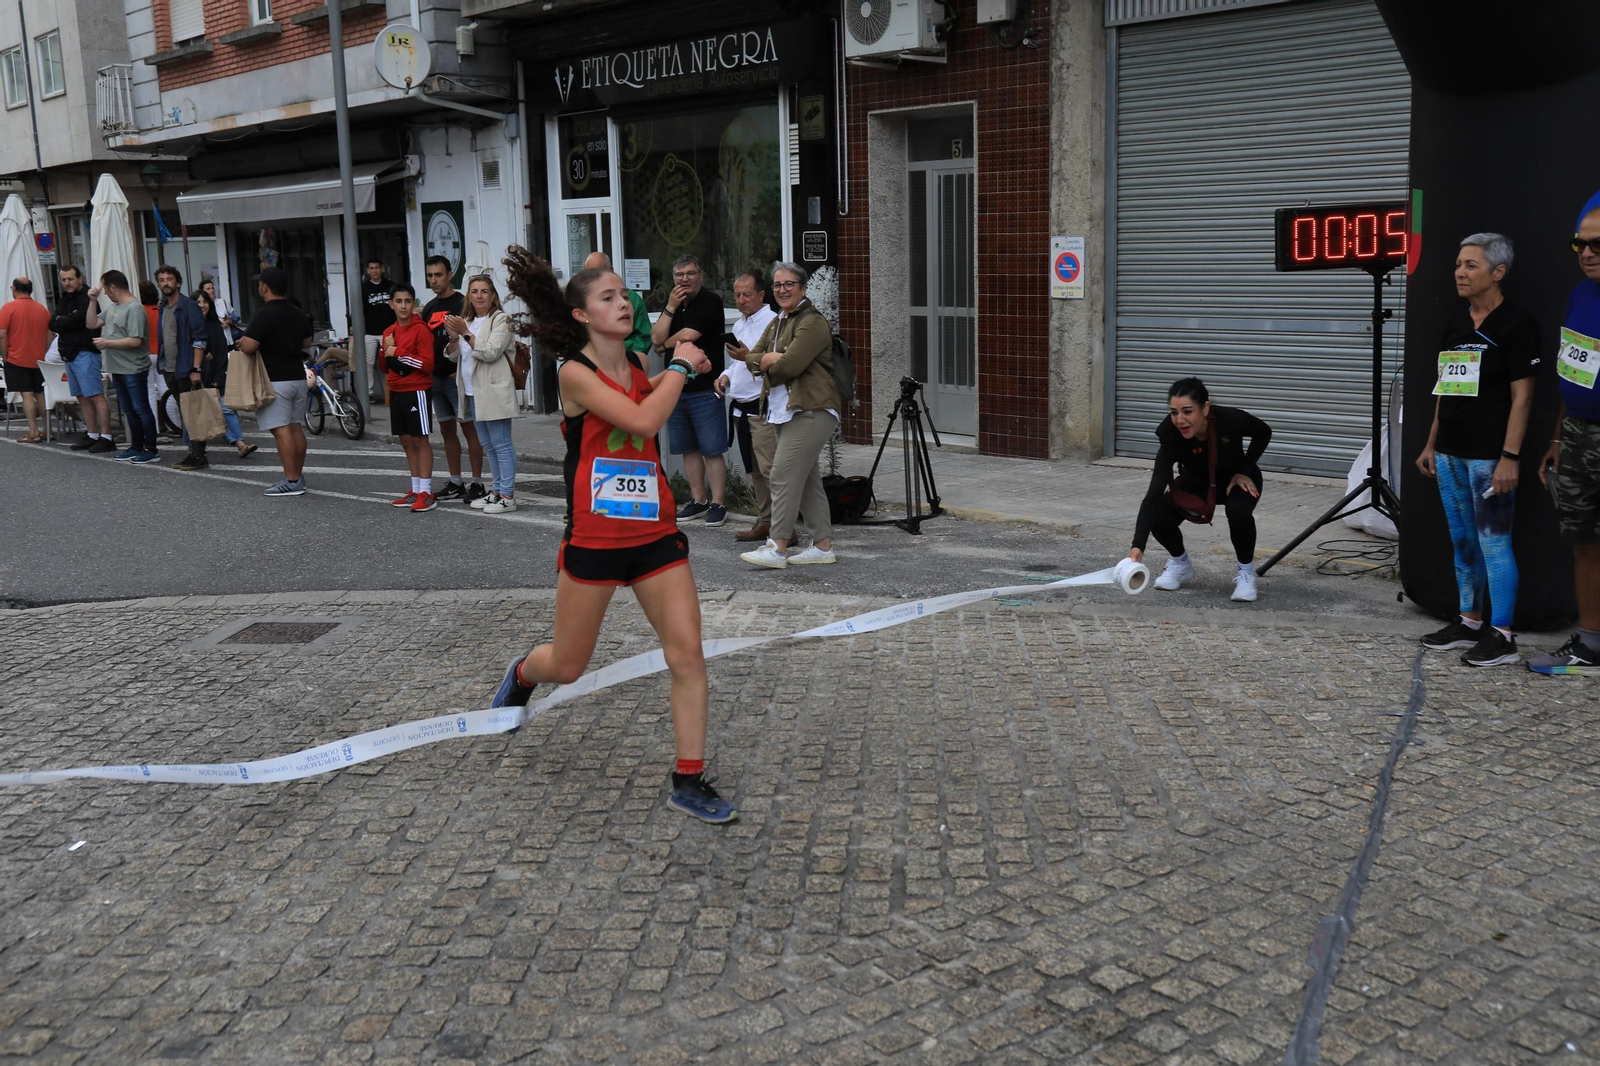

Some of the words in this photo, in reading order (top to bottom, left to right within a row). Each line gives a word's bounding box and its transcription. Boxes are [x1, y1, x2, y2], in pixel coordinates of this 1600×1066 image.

[581, 43, 684, 89] ETIQUETA
[689, 26, 779, 74] NEGRA
[708, 65, 780, 88] Autoservicio
[587, 141, 595, 151] en
[595, 138, 607, 151] solo
[953, 140, 962, 158] 3
[572, 159, 585, 179] 30
[590, 169, 608, 179] minutos
[1568, 346, 1588, 363] 208
[1448, 364, 1467, 376] 210
[615, 477, 647, 493] 303
[418, 720, 453, 732] OURENSE
[486, 715, 513, 724] DEPORTE
[407, 726, 454, 741] DEPUTACIÓN
[371, 735, 400, 747] DEPORTE
[304, 748, 339, 762] OURENSE
[295, 755, 341, 772] DEPUTACIÓN
[198, 769, 238, 777] DEPUTACIÓN
